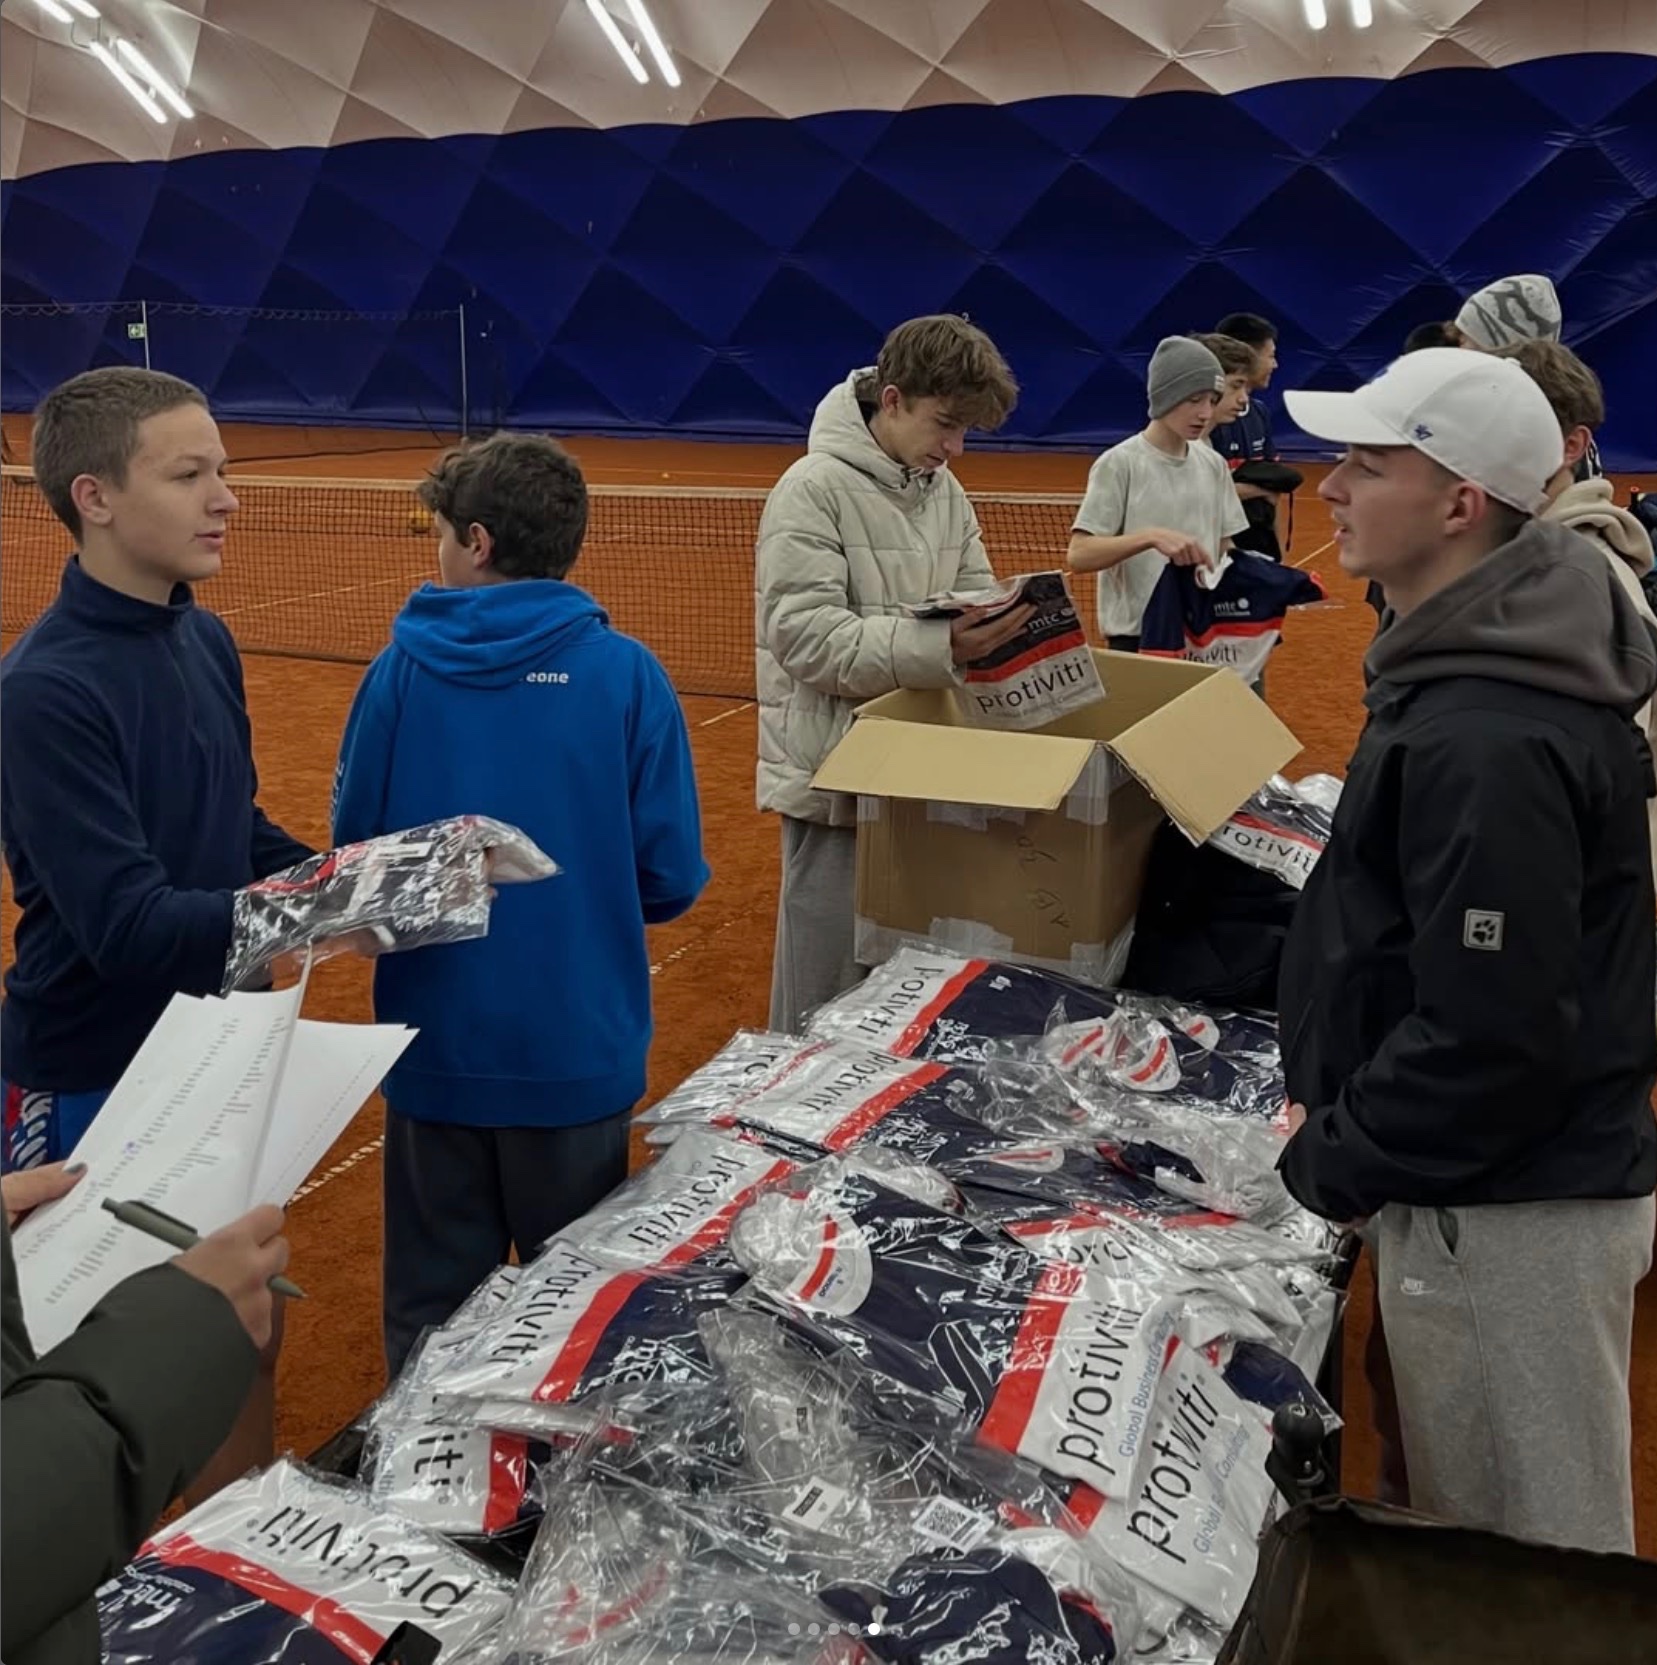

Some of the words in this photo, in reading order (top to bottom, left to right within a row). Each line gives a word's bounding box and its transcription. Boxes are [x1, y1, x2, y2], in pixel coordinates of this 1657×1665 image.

[1028, 612, 1060, 631] mtc
[976, 657, 1085, 714] protiviti
[1222, 826, 1315, 873] rotivit
[628, 1154, 747, 1247] protiviti
[488, 1251, 602, 1364] protiviti
[1056, 1301, 1143, 1476] protiviti
[1119, 1410, 1144, 1458] Global
[1127, 1373, 1219, 1564] protiviti
[248, 1506, 480, 1618] protiviti
